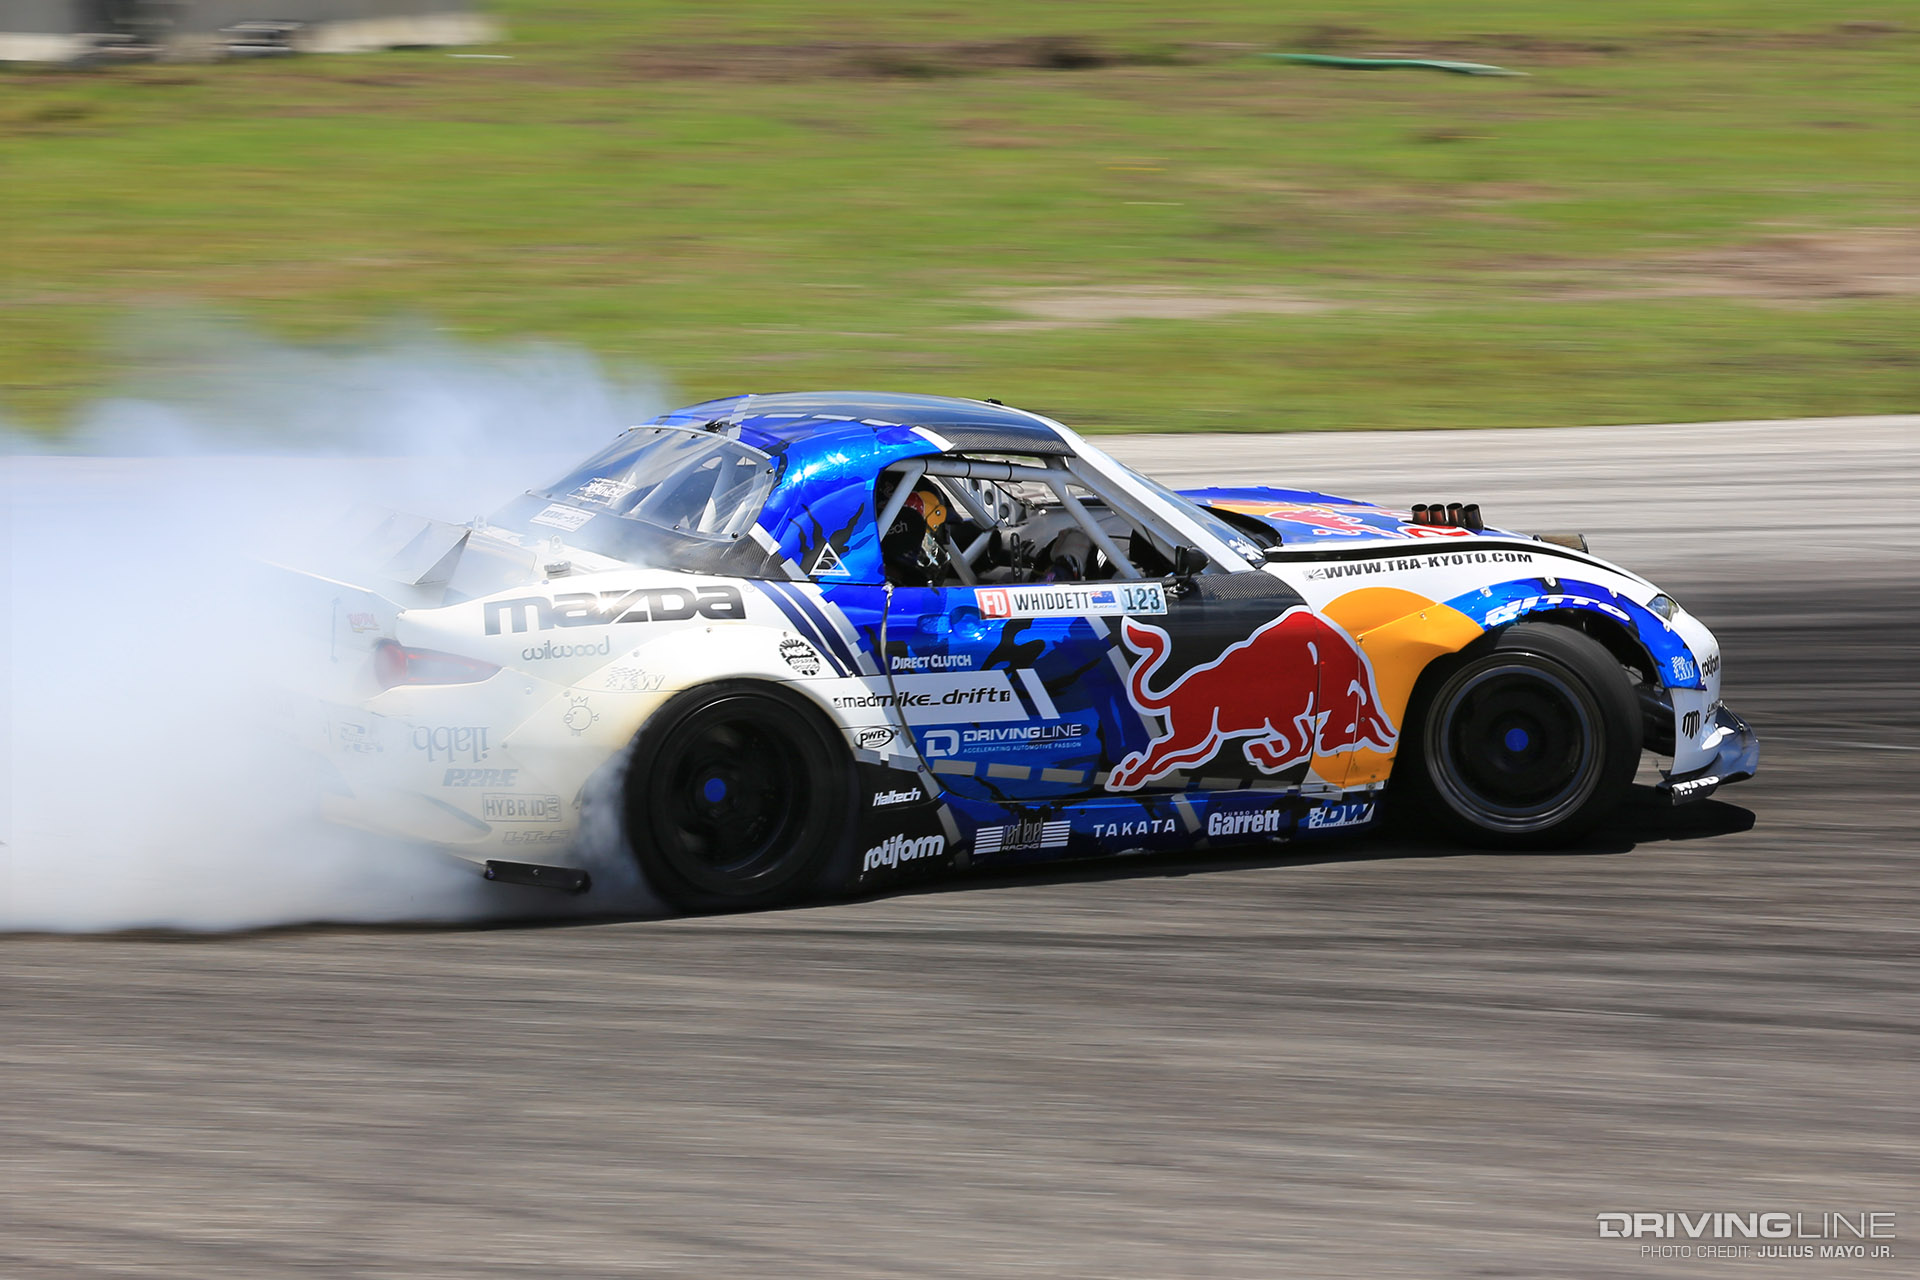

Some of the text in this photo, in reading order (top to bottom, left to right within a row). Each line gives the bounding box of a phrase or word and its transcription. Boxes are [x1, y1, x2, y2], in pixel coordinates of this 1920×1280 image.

[1324, 552, 1533, 579] WWW.TRA-KYOTO.COM
[1013, 591, 1089, 611] WHIDDETT
[1124, 587, 1160, 610] 123
[521, 635, 611, 661] wilwood
[891, 654, 972, 670] DIRECT CLUTCH
[843, 687, 998, 708] madmike_drift
[860, 729, 887, 749] PWR
[963, 724, 1082, 742] DRIVINGLINE
[872, 787, 921, 806] Haltech
[486, 799, 546, 817] HYBRID
[1093, 819, 1176, 838] TAKATA
[1208, 809, 1280, 836] Garrett
[863, 833, 945, 872] rotiform
[1001, 842, 1040, 851] RACING
